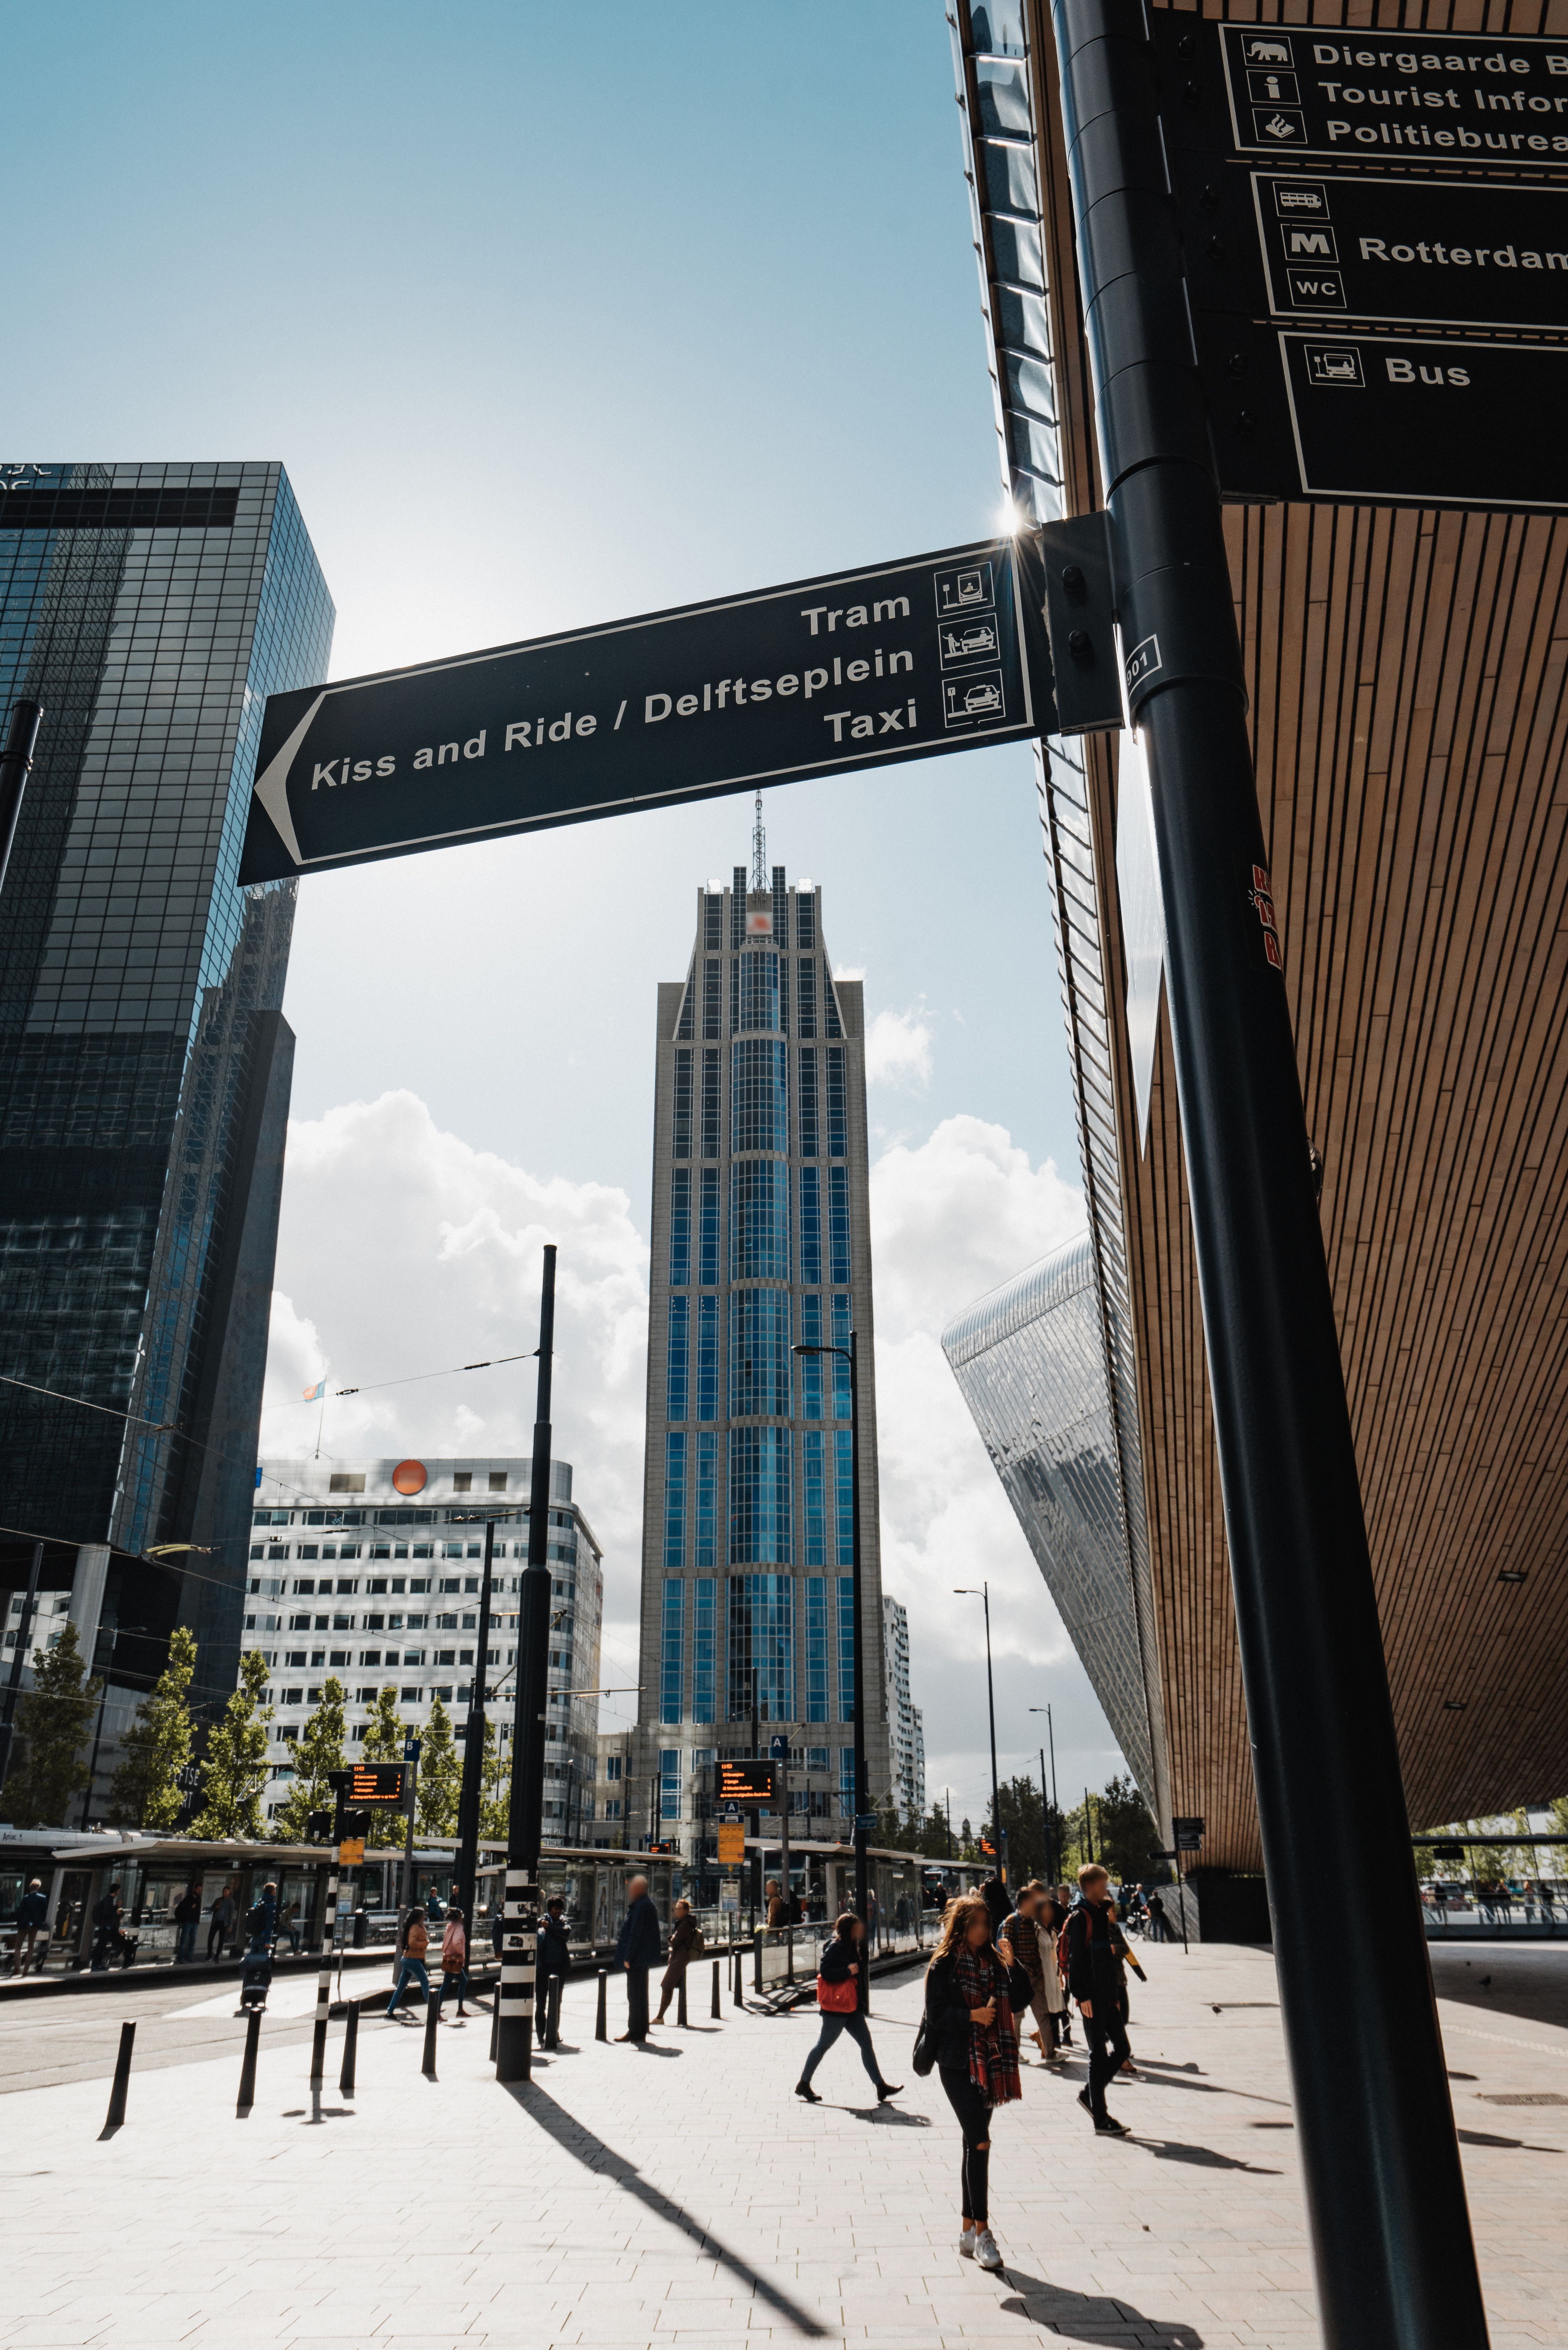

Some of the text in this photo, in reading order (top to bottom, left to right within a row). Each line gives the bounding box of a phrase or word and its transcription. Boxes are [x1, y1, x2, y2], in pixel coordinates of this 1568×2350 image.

[1313, 45, 1530, 73] Diergaarde
[1318, 82, 1461, 108] Tourist
[1327, 121, 1568, 151] Politieburea
[1291, 233, 1330, 254] M
[1359, 238, 1568, 270] Rotterdam
[1296, 281, 1336, 295] WC
[1386, 358, 1470, 386] Bus
[801, 597, 909, 635] Tram
[312, 757, 395, 790] Kiss
[413, 730, 486, 769] and
[505, 712, 597, 751] Ride
[645, 649, 913, 723] Delftseplein
[824, 698, 916, 742] Taxi
[407, 1741, 413, 1750] B
[773, 1737, 782, 1747] A
[728, 1803, 736, 1811] A
